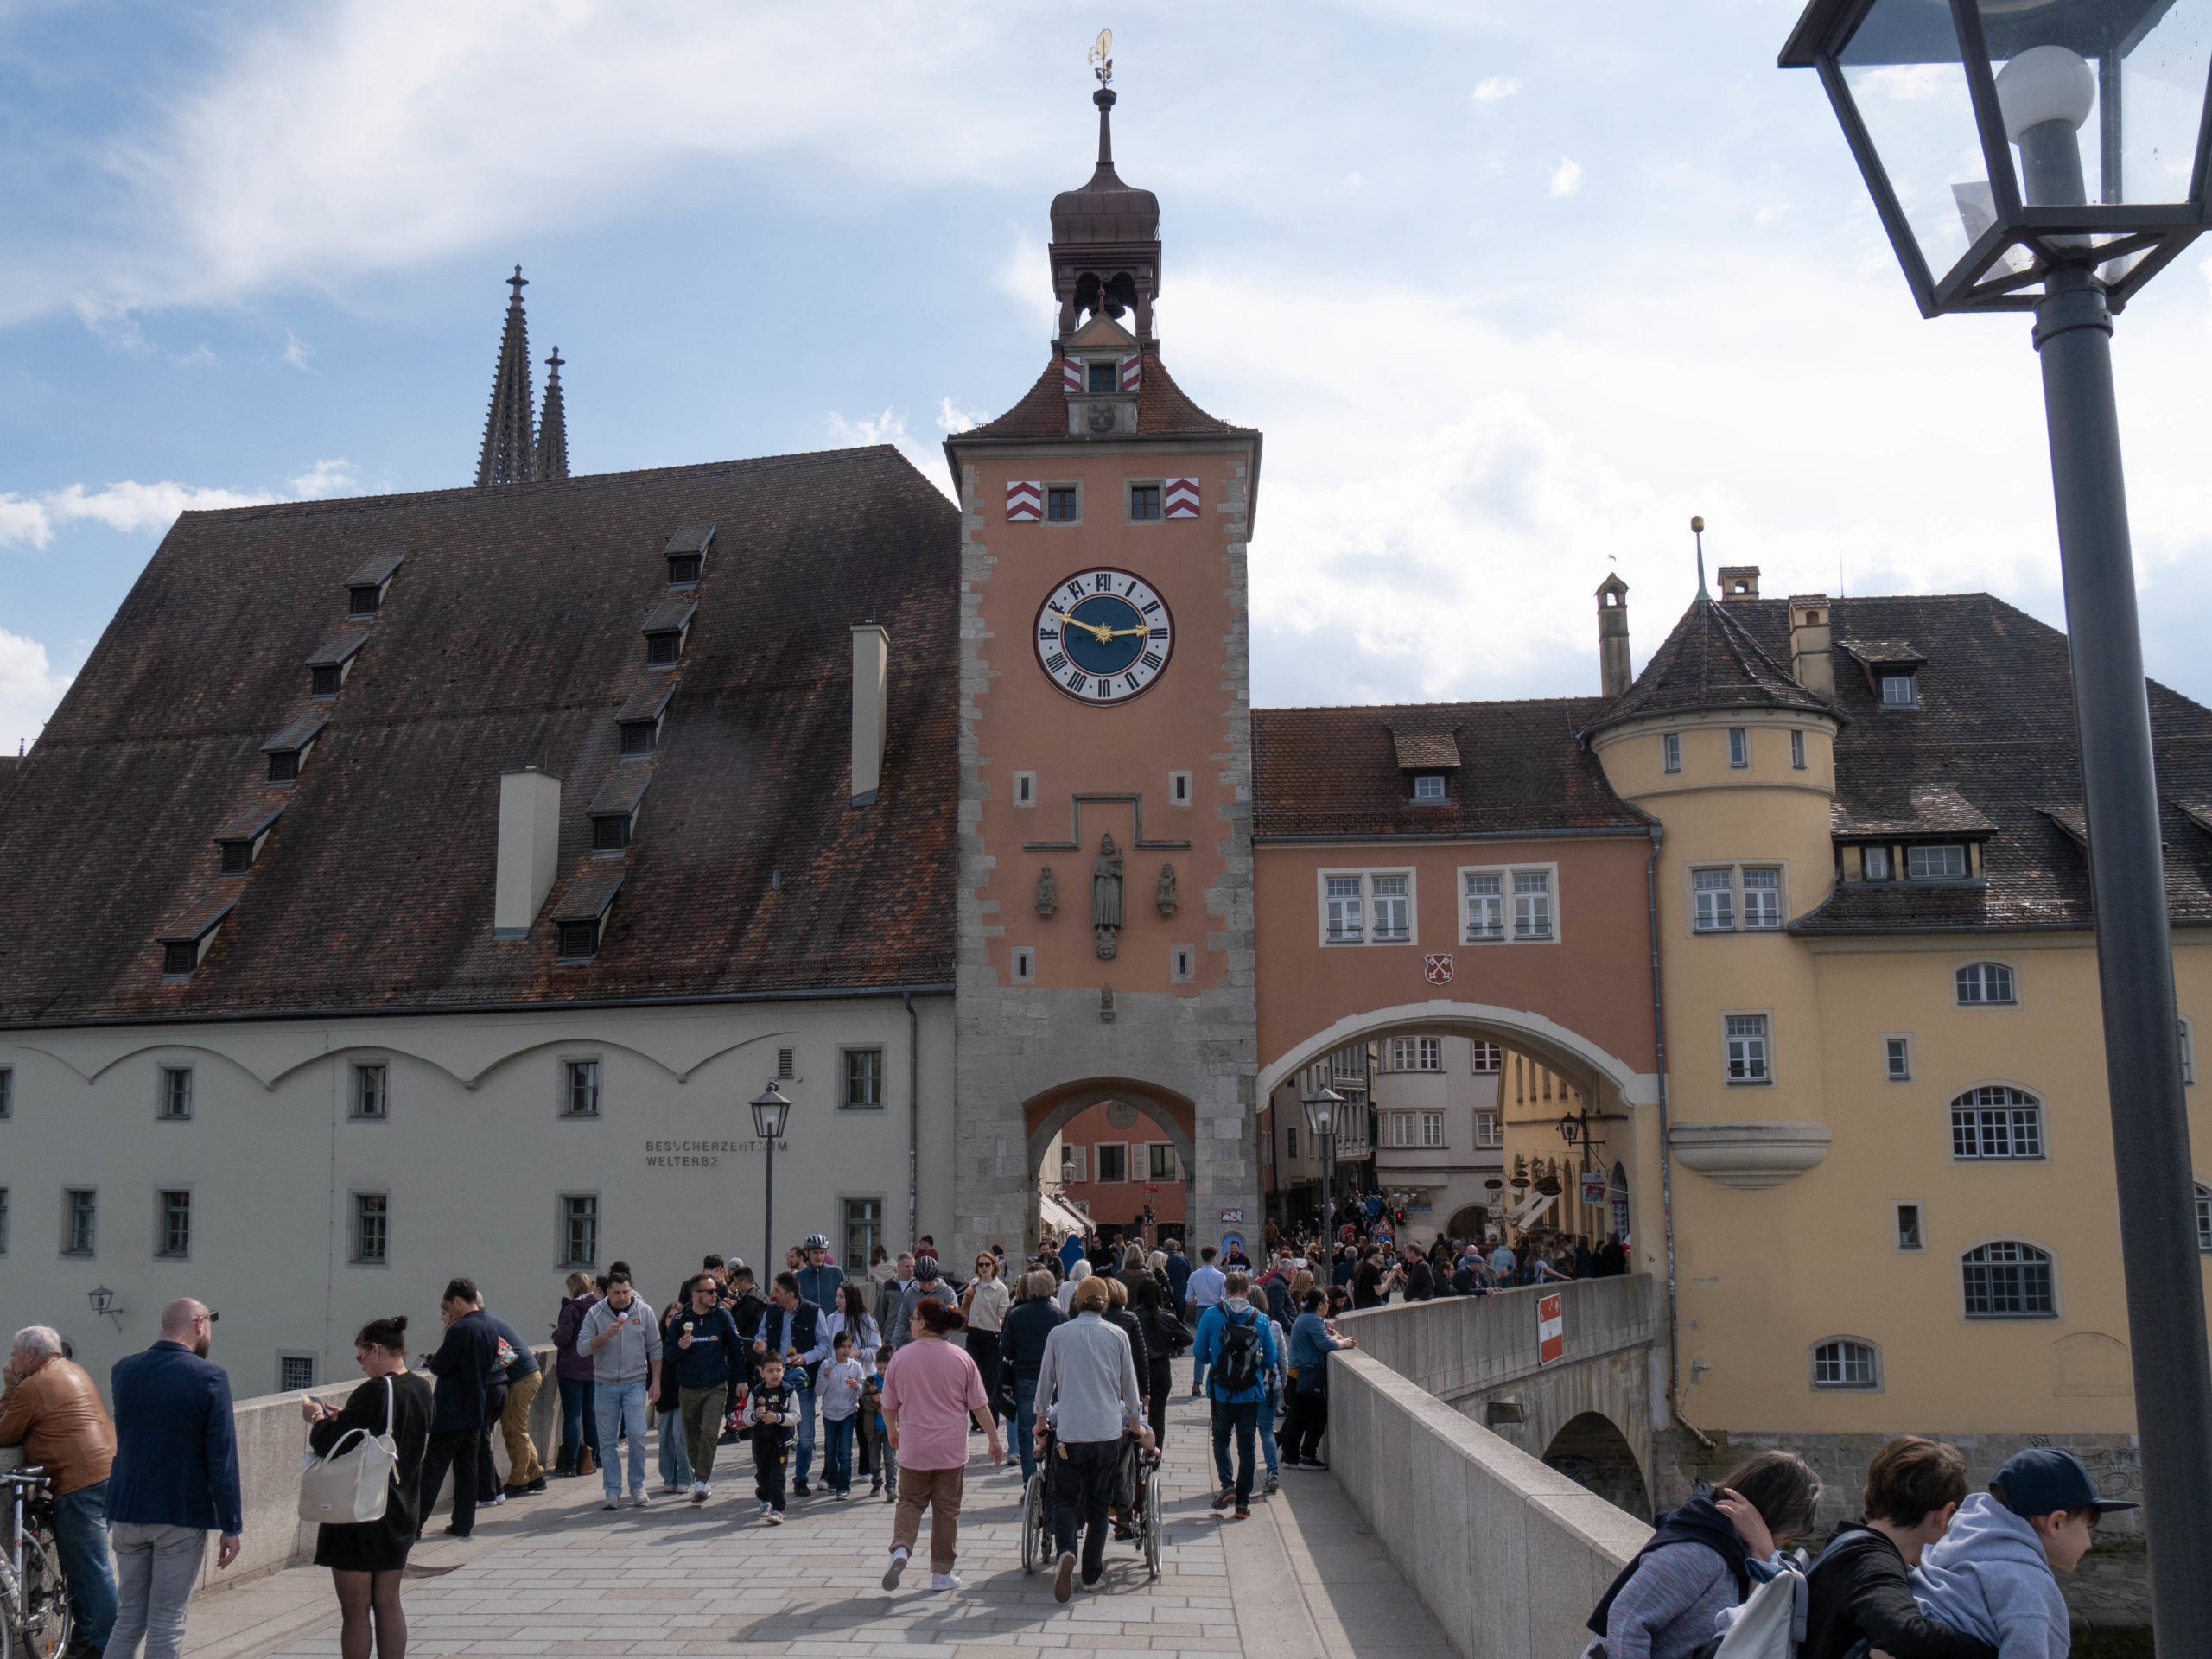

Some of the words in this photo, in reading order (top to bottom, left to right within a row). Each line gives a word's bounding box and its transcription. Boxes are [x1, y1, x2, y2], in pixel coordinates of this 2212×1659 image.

[1125, 581, 1137, 597] I
[1141, 600, 1160, 615] II
[1149, 628, 1168, 639] III
[1046, 652, 1067, 673] VIII
[1141, 651, 1162, 671] IIII
[1067, 671, 1087, 692] VII
[1098, 679, 1110, 697] VI
[646, 1156, 718, 1166] WELTERBE
